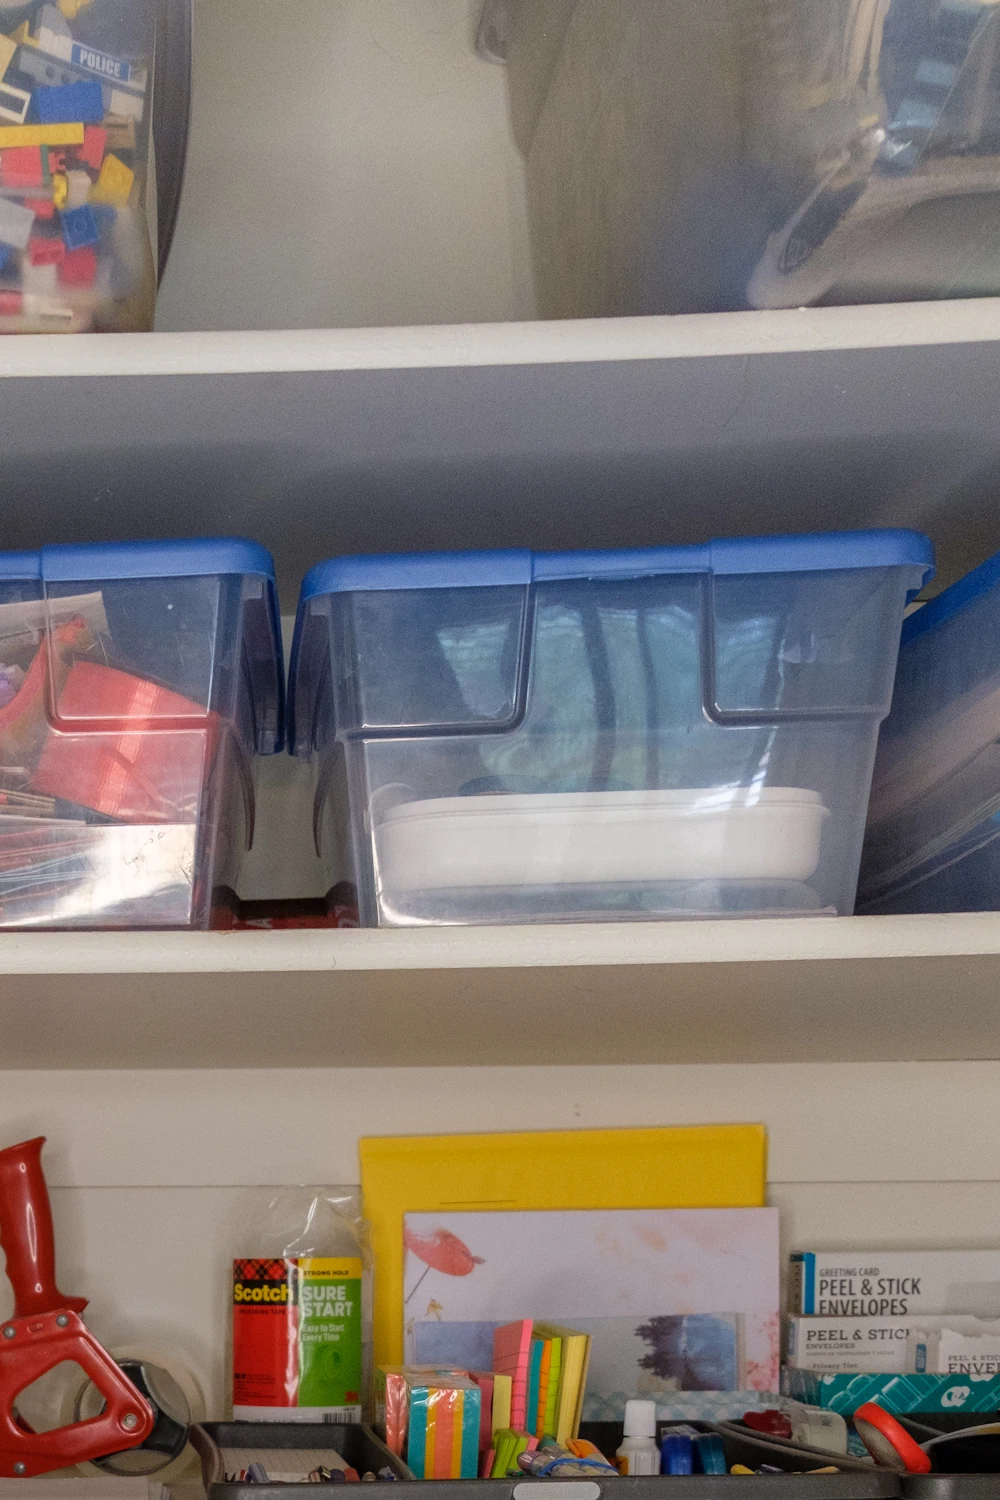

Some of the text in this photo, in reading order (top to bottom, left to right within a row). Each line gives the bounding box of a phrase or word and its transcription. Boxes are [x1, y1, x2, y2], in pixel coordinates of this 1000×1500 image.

[80, 49, 120, 77] POLICE
[820, 1268, 880, 1276] GREETING CARD
[235, 1283, 293, 1301] Scotch
[302, 1286, 346, 1300] SURE
[820, 1278, 921, 1296] PEEL & STICK
[303, 1302, 353, 1317] START
[819, 1299, 908, 1315] ENVELOPES
[807, 1330, 848, 1341] PEEL
